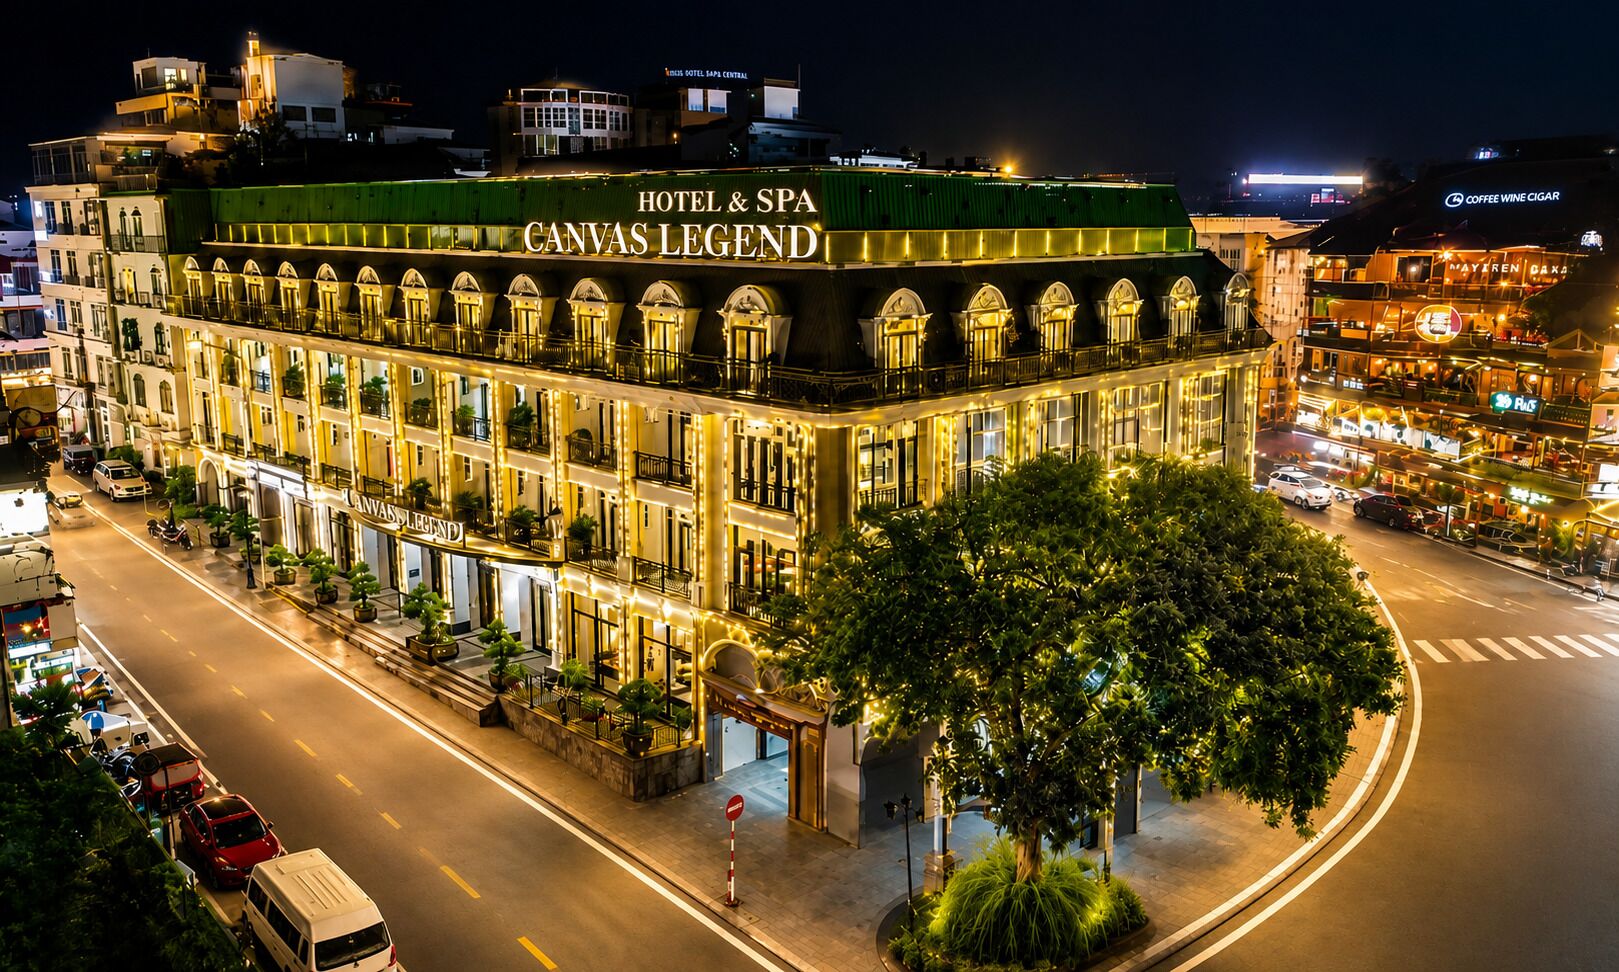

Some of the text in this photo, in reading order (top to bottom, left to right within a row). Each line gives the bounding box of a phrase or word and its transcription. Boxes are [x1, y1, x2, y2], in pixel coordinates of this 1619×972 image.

[637, 188, 818, 213] HOTEL & SPA
[1465, 194, 1500, 205] COFFEE
[1500, 192, 1527, 203] WINE
[1527, 191, 1560, 202] CIGAR
[524, 221, 818, 259] CANVAS LEGEND
